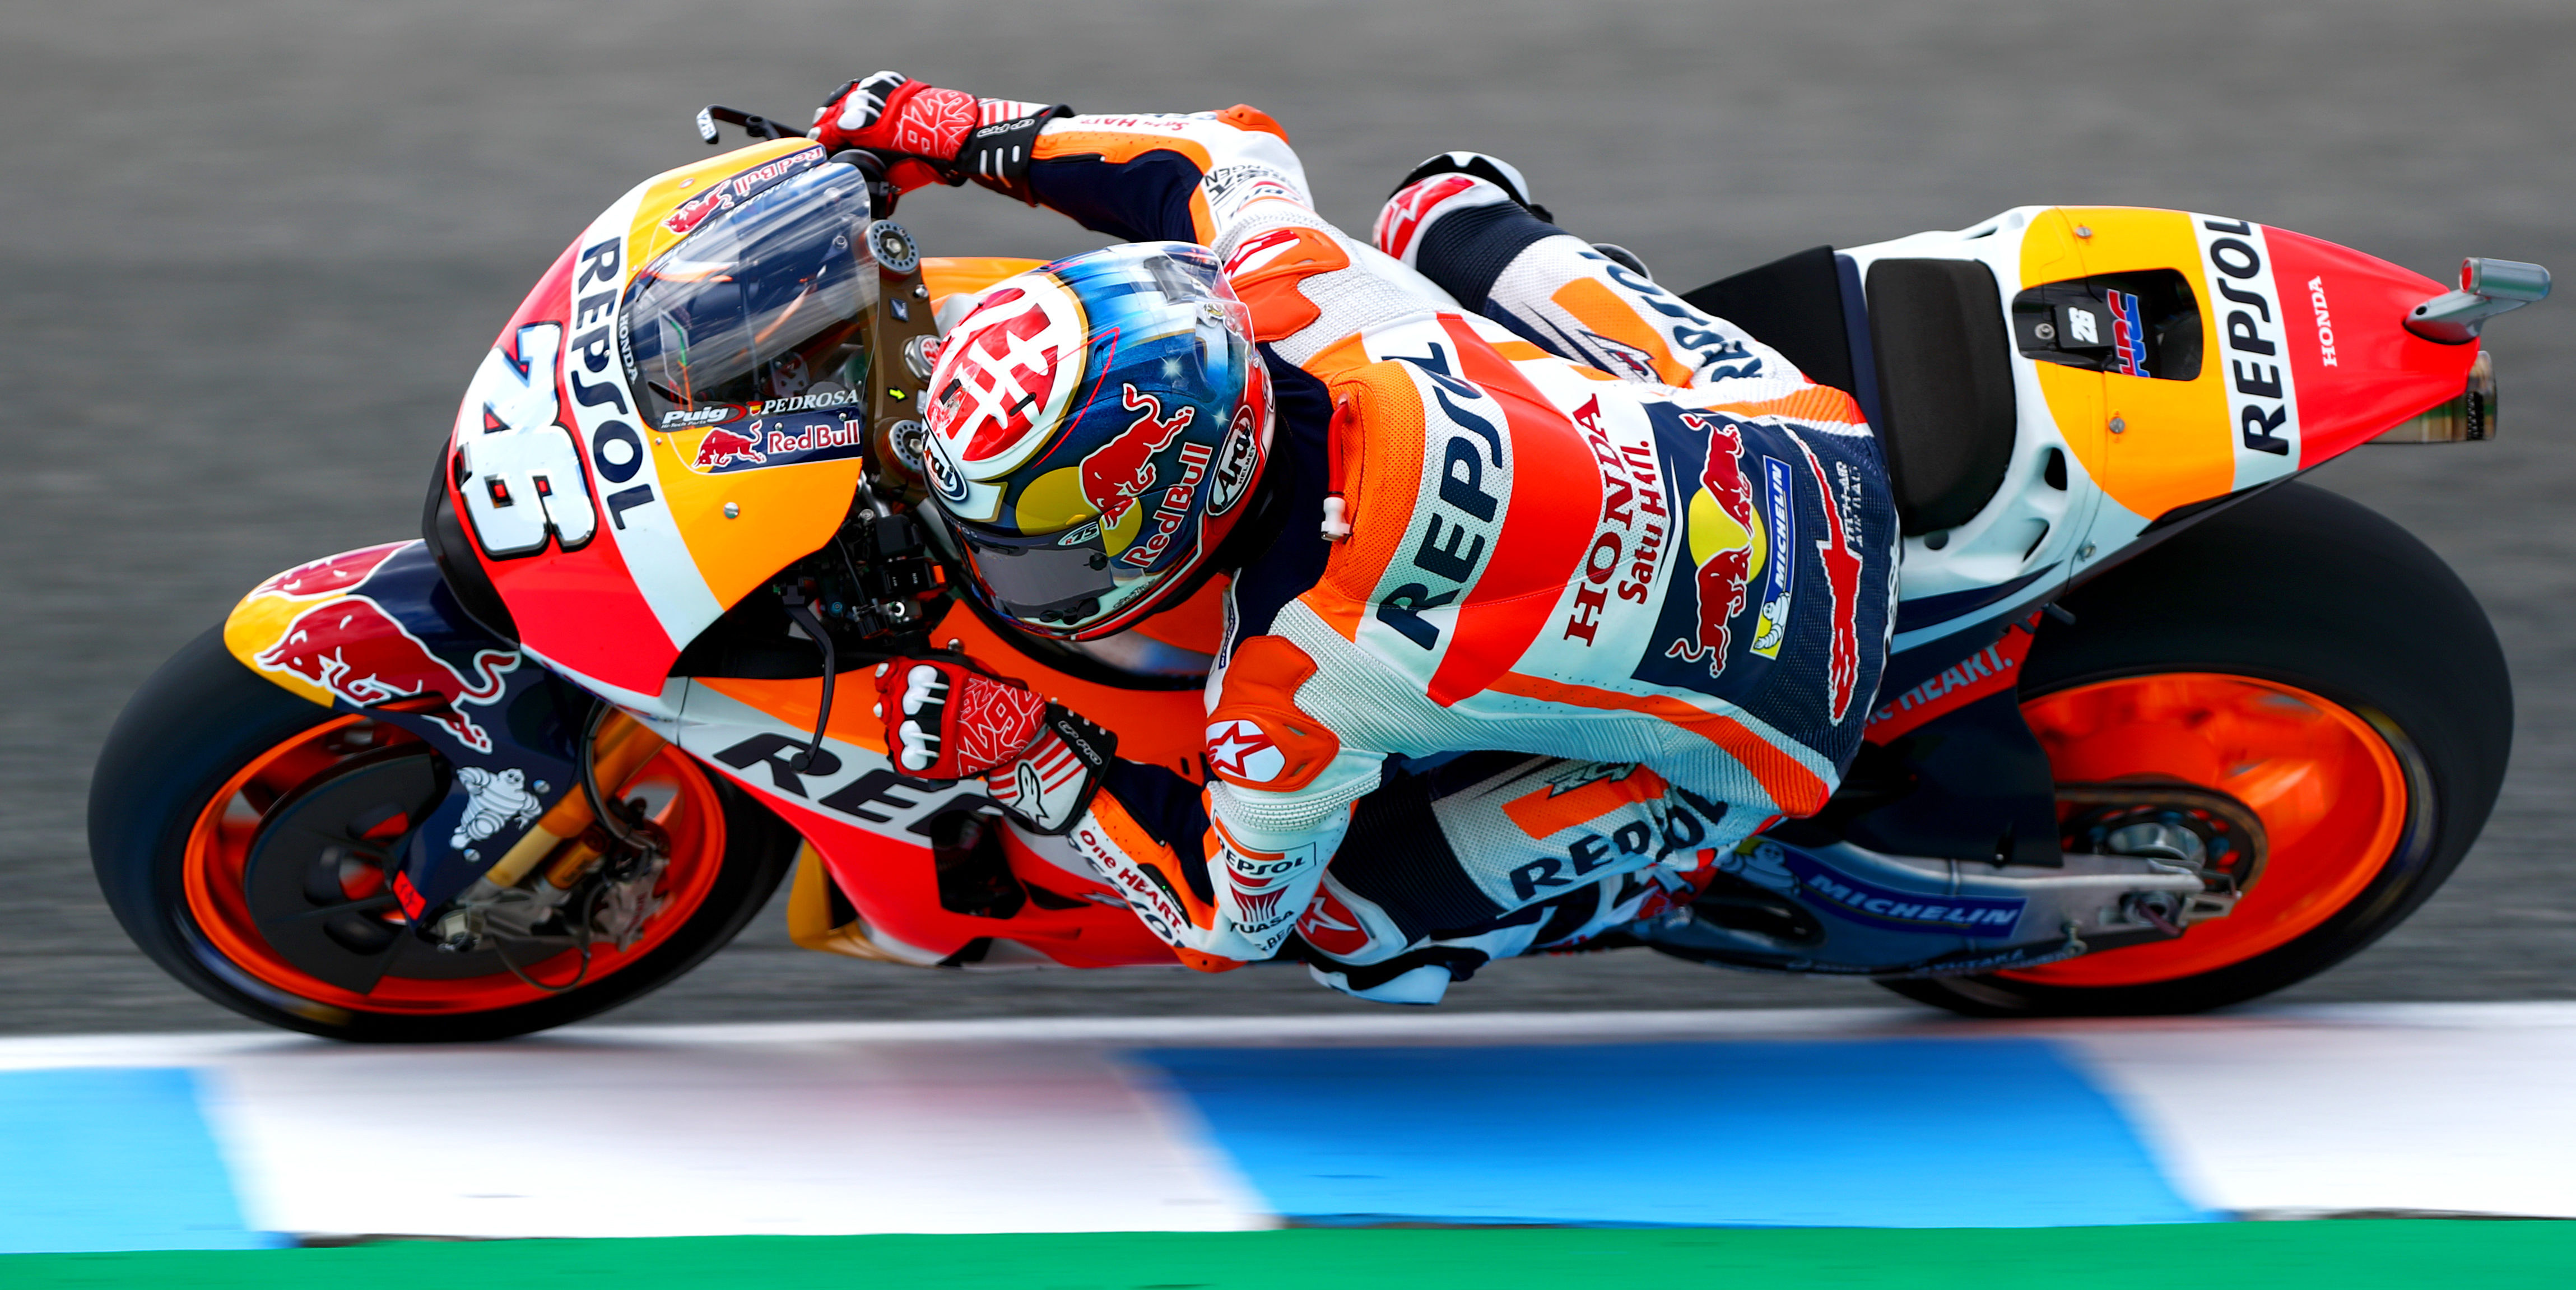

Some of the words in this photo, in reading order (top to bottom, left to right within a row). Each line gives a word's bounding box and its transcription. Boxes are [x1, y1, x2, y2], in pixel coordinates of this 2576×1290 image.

[733, 164, 776, 195] Bull
[779, 147, 822, 173] Red
[619, 312, 638, 384] HONDA
[2068, 307, 2098, 344] 26
[2107, 289, 2149, 377] HRC
[2206, 219, 2289, 456] REPSOL
[2308, 276, 2337, 368] HONDA
[571, 236, 654, 530] REPSOL
[662, 406, 729, 425] Puig
[761, 389, 858, 415] PEDROSA
[457, 321, 598, 561] 26
[768, 425, 812, 454] Red
[814, 419, 860, 449] Bull
[1215, 423, 1255, 509] Arai
[1239, 444, 1257, 484] HELMET
[1120, 509, 1179, 568] Red
[1168, 443, 1213, 511] Bull
[1377, 342, 1503, 650] REPSOL
[1564, 393, 1633, 646] HONDA
[1771, 463, 1785, 585] MICHELIN
[1617, 527, 1663, 604] Satu
[1080, 829, 1117, 869] One
[1217, 835, 1306, 876] REPSOL
[1230, 909, 1295, 934] YUASA
[1808, 874, 2017, 926] MICHELIN
